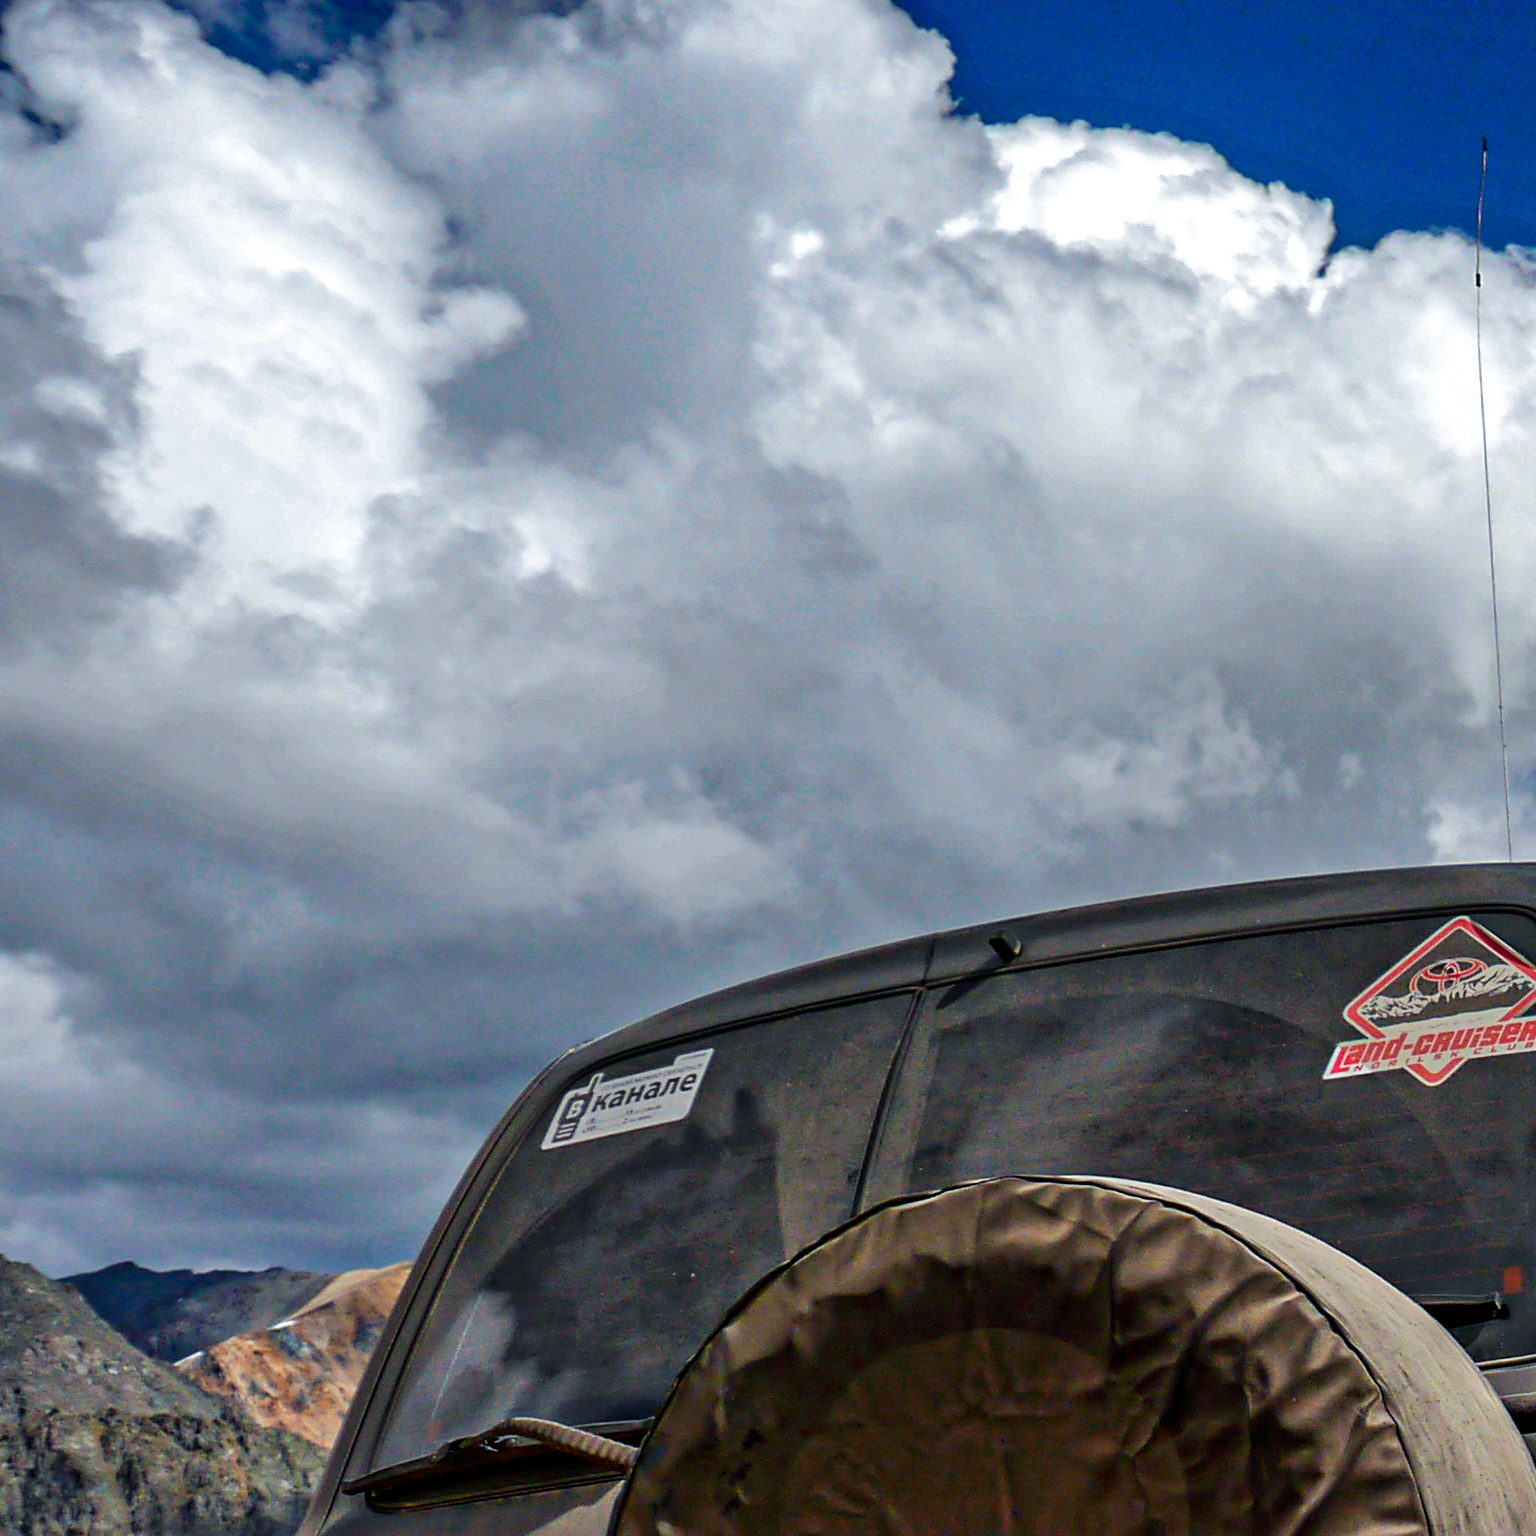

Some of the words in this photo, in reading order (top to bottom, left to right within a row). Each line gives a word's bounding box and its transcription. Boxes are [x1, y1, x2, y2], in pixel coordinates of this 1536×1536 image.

[1354, 1051, 1462, 1071] NORILSK
[1473, 1041, 1535, 1060] CLUB
[592, 1073, 697, 1112] канале
